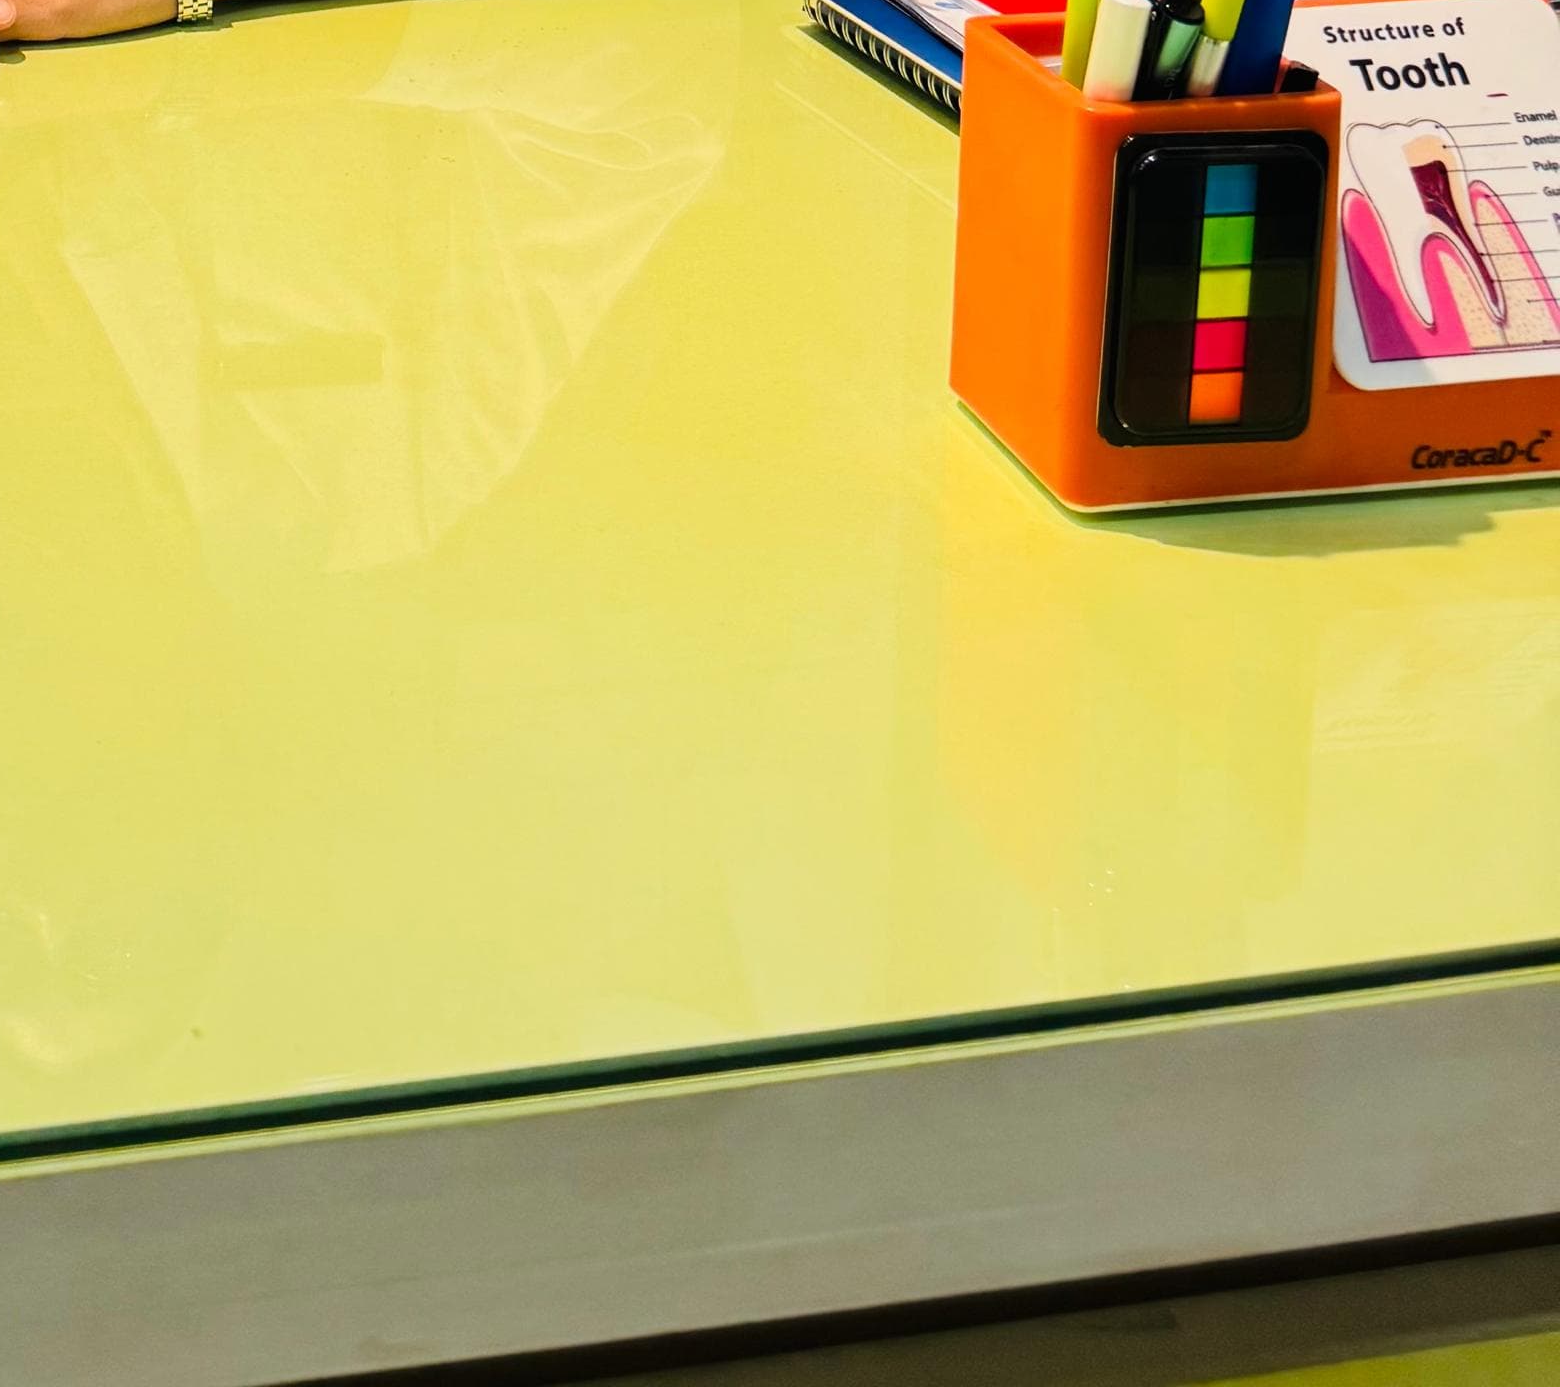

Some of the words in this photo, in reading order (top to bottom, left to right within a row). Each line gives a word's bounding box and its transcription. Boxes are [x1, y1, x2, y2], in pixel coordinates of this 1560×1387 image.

[1323, 23, 1435, 44] Structure
[1442, 16, 1465, 36] of
[1349, 52, 1471, 92] Tooth
[1514, 110, 1558, 123] Enamel
